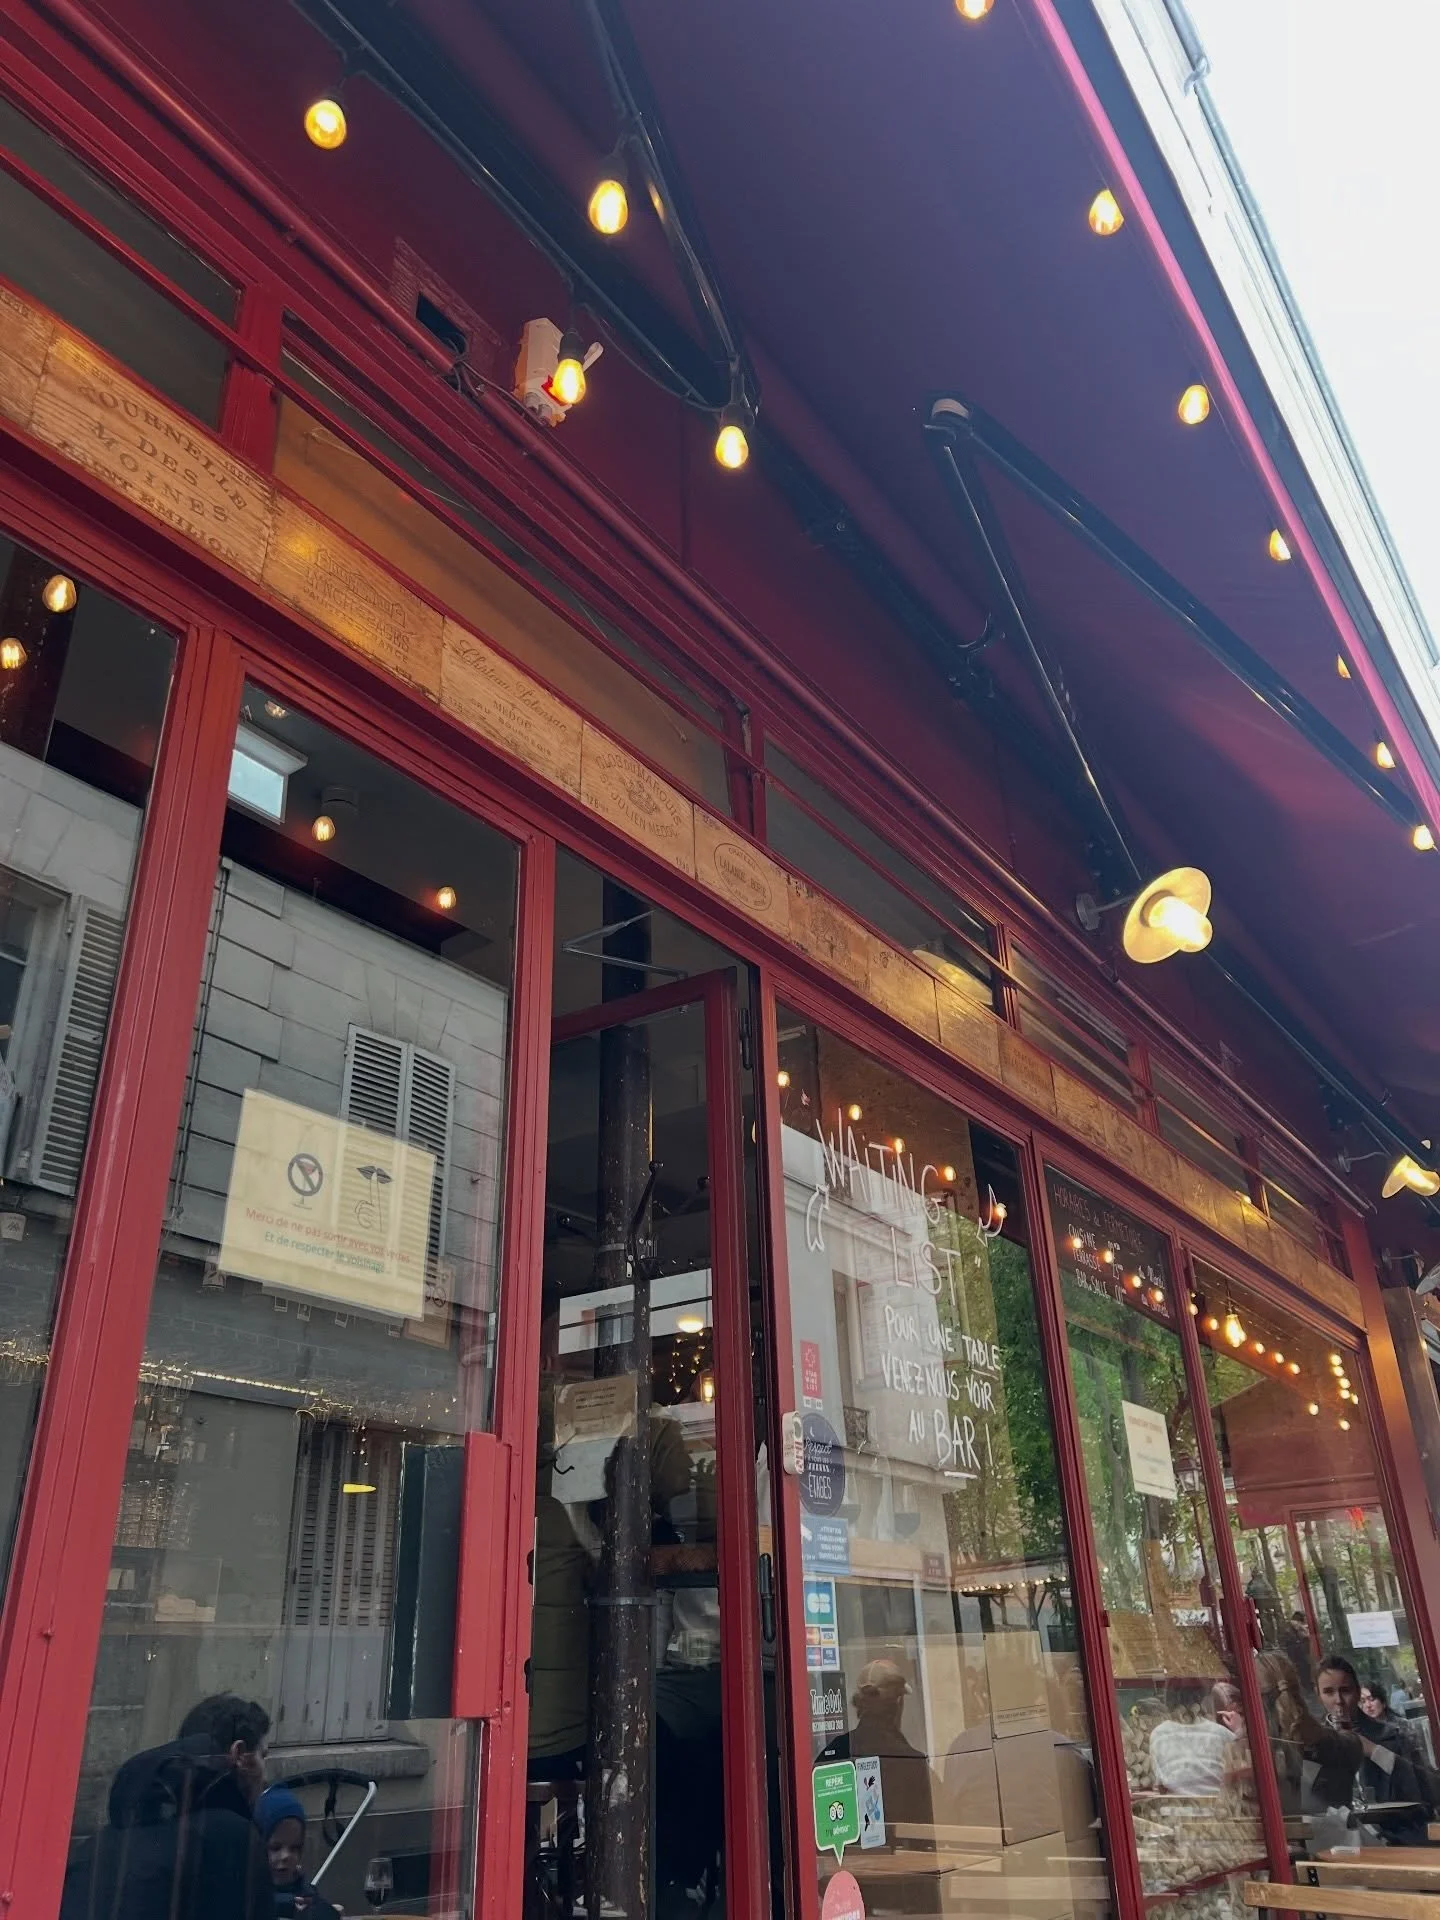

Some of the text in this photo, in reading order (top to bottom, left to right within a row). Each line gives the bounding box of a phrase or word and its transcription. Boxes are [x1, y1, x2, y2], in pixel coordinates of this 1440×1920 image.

[78, 385, 248, 511] TOURNELLE
[89, 421, 230, 523] MOINES
[137, 434, 199, 487] DES
[264, 1231, 275, 1243] Et
[276, 1235, 290, 1247] de
[291, 1241, 335, 1259] respecter
[276, 1216, 289, 1229] de
[291, 1221, 303, 1233] ne
[305, 1224, 321, 1238] pas
[323, 1230, 348, 1243] sortir
[884, 1303, 1002, 1372] POUR UNE TABLE
[880, 1350, 924, 1396] VENEZ
[925, 1362, 961, 1402] NOUS
[908, 1408, 925, 1446] AU
[933, 1407, 982, 1472] BAR
[823, 1632, 834, 1640] VISA
